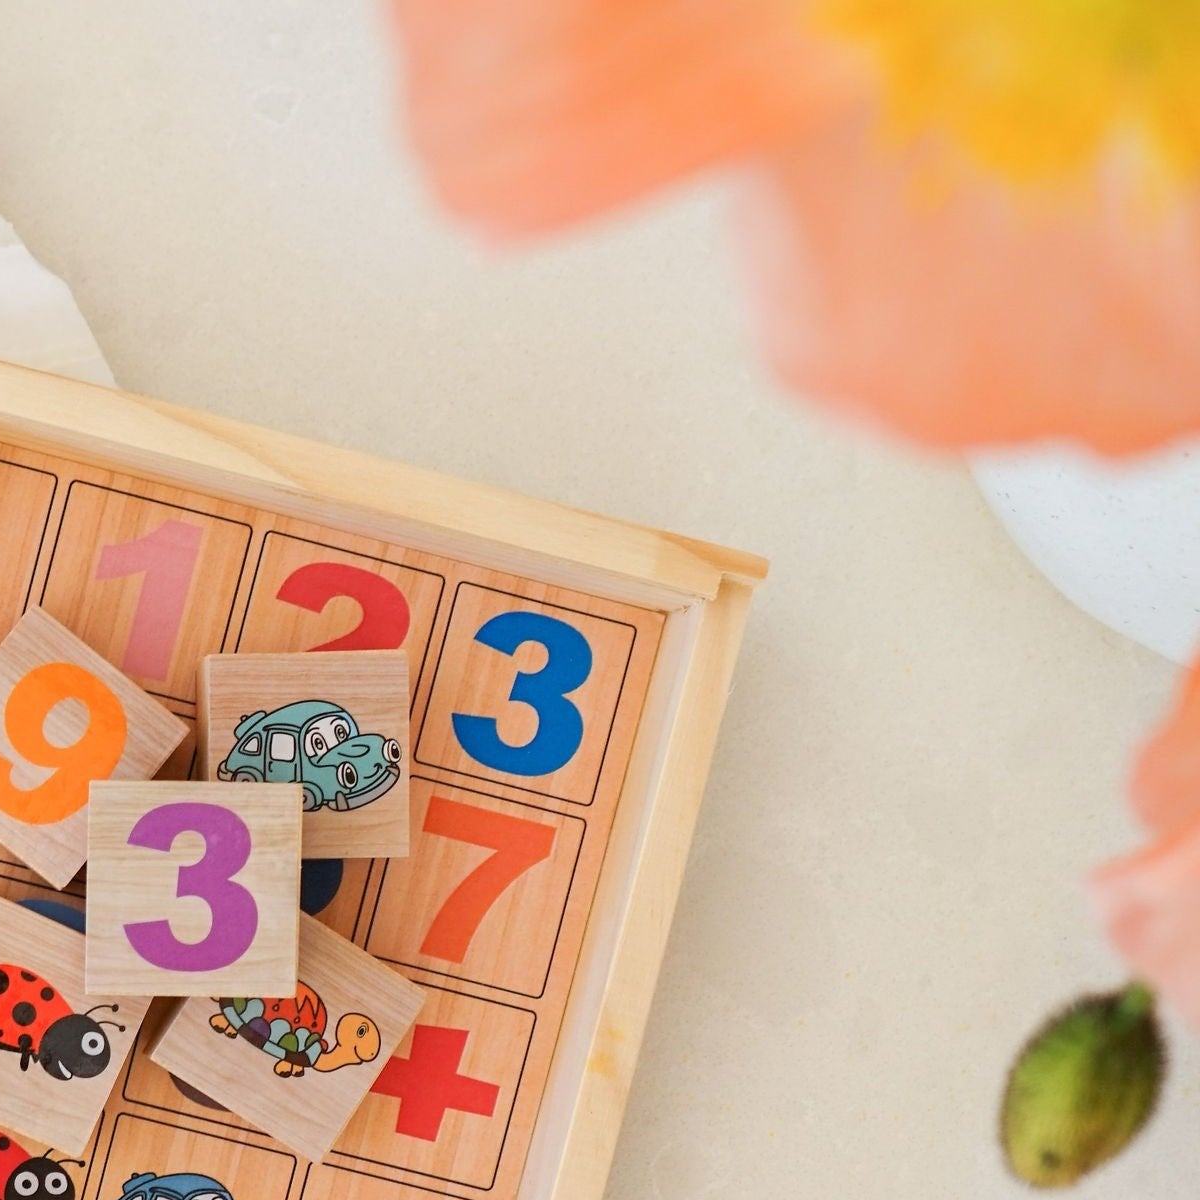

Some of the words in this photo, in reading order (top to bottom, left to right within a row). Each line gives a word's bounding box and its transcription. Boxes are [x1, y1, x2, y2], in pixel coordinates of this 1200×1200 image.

[95, 519, 203, 682] 1
[275, 561, 411, 652] 2
[451, 610, 594, 777] 3
[122, 802, 259, 972] 3
[421, 795, 557, 964] 7
